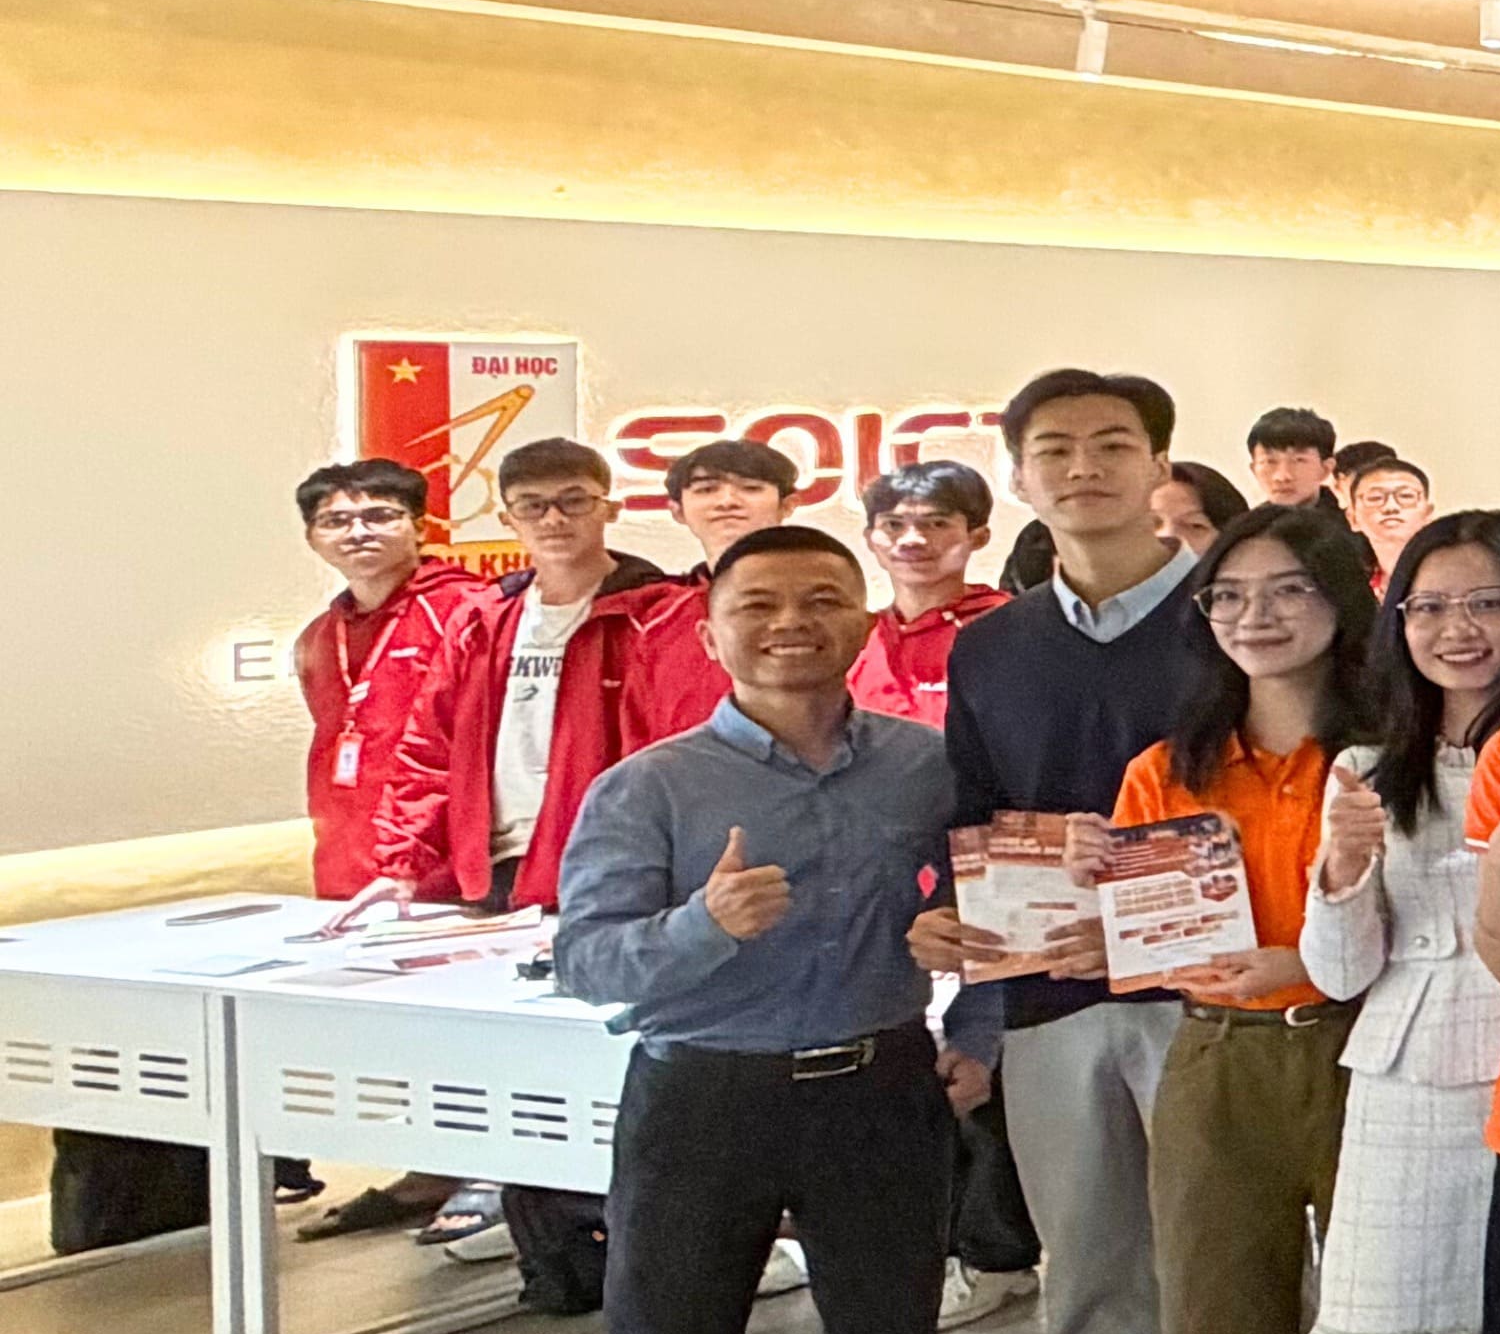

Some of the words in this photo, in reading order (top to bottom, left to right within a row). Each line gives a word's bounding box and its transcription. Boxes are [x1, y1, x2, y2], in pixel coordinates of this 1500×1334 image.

[472, 356, 508, 378] ĐẠI
[515, 356, 557, 378] HỌC
[615, 411, 1003, 509] SOIC
